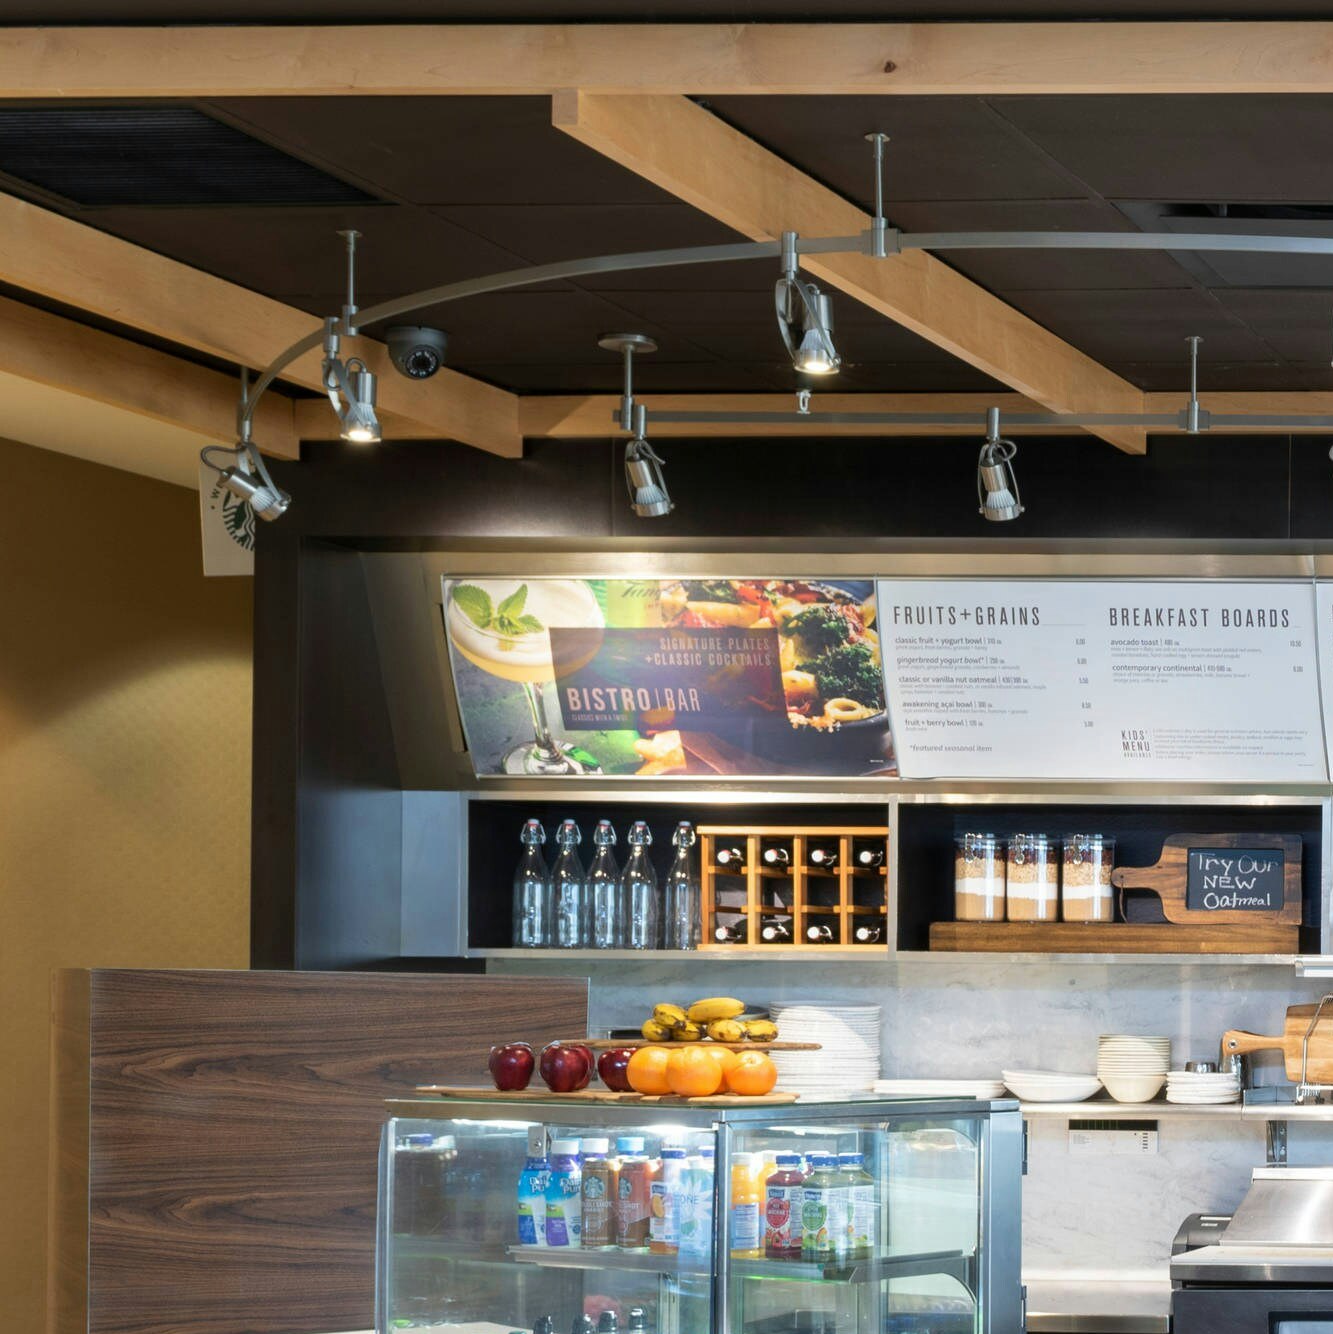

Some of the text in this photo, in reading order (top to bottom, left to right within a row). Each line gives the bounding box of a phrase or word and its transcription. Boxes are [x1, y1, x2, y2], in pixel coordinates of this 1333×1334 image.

[1109, 608, 1289, 628] BREAKFAST BOARDS
[660, 637, 770, 651] SIGNATURE PLATES
[941, 637, 963, 645] yogurt
[709, 653, 772, 666] COCKTAILS
[897, 657, 938, 665] gingerbread
[940, 657, 963, 665] yogurt
[1113, 665, 1161, 673] contemporary
[566, 688, 701, 712] BISTRO BAR
[1123, 742, 1150, 752] MENU
[1191, 852, 1278, 876] Try Our
[1203, 875, 1257, 889] NEW
[1203, 892, 1271, 909] Oatmeal
